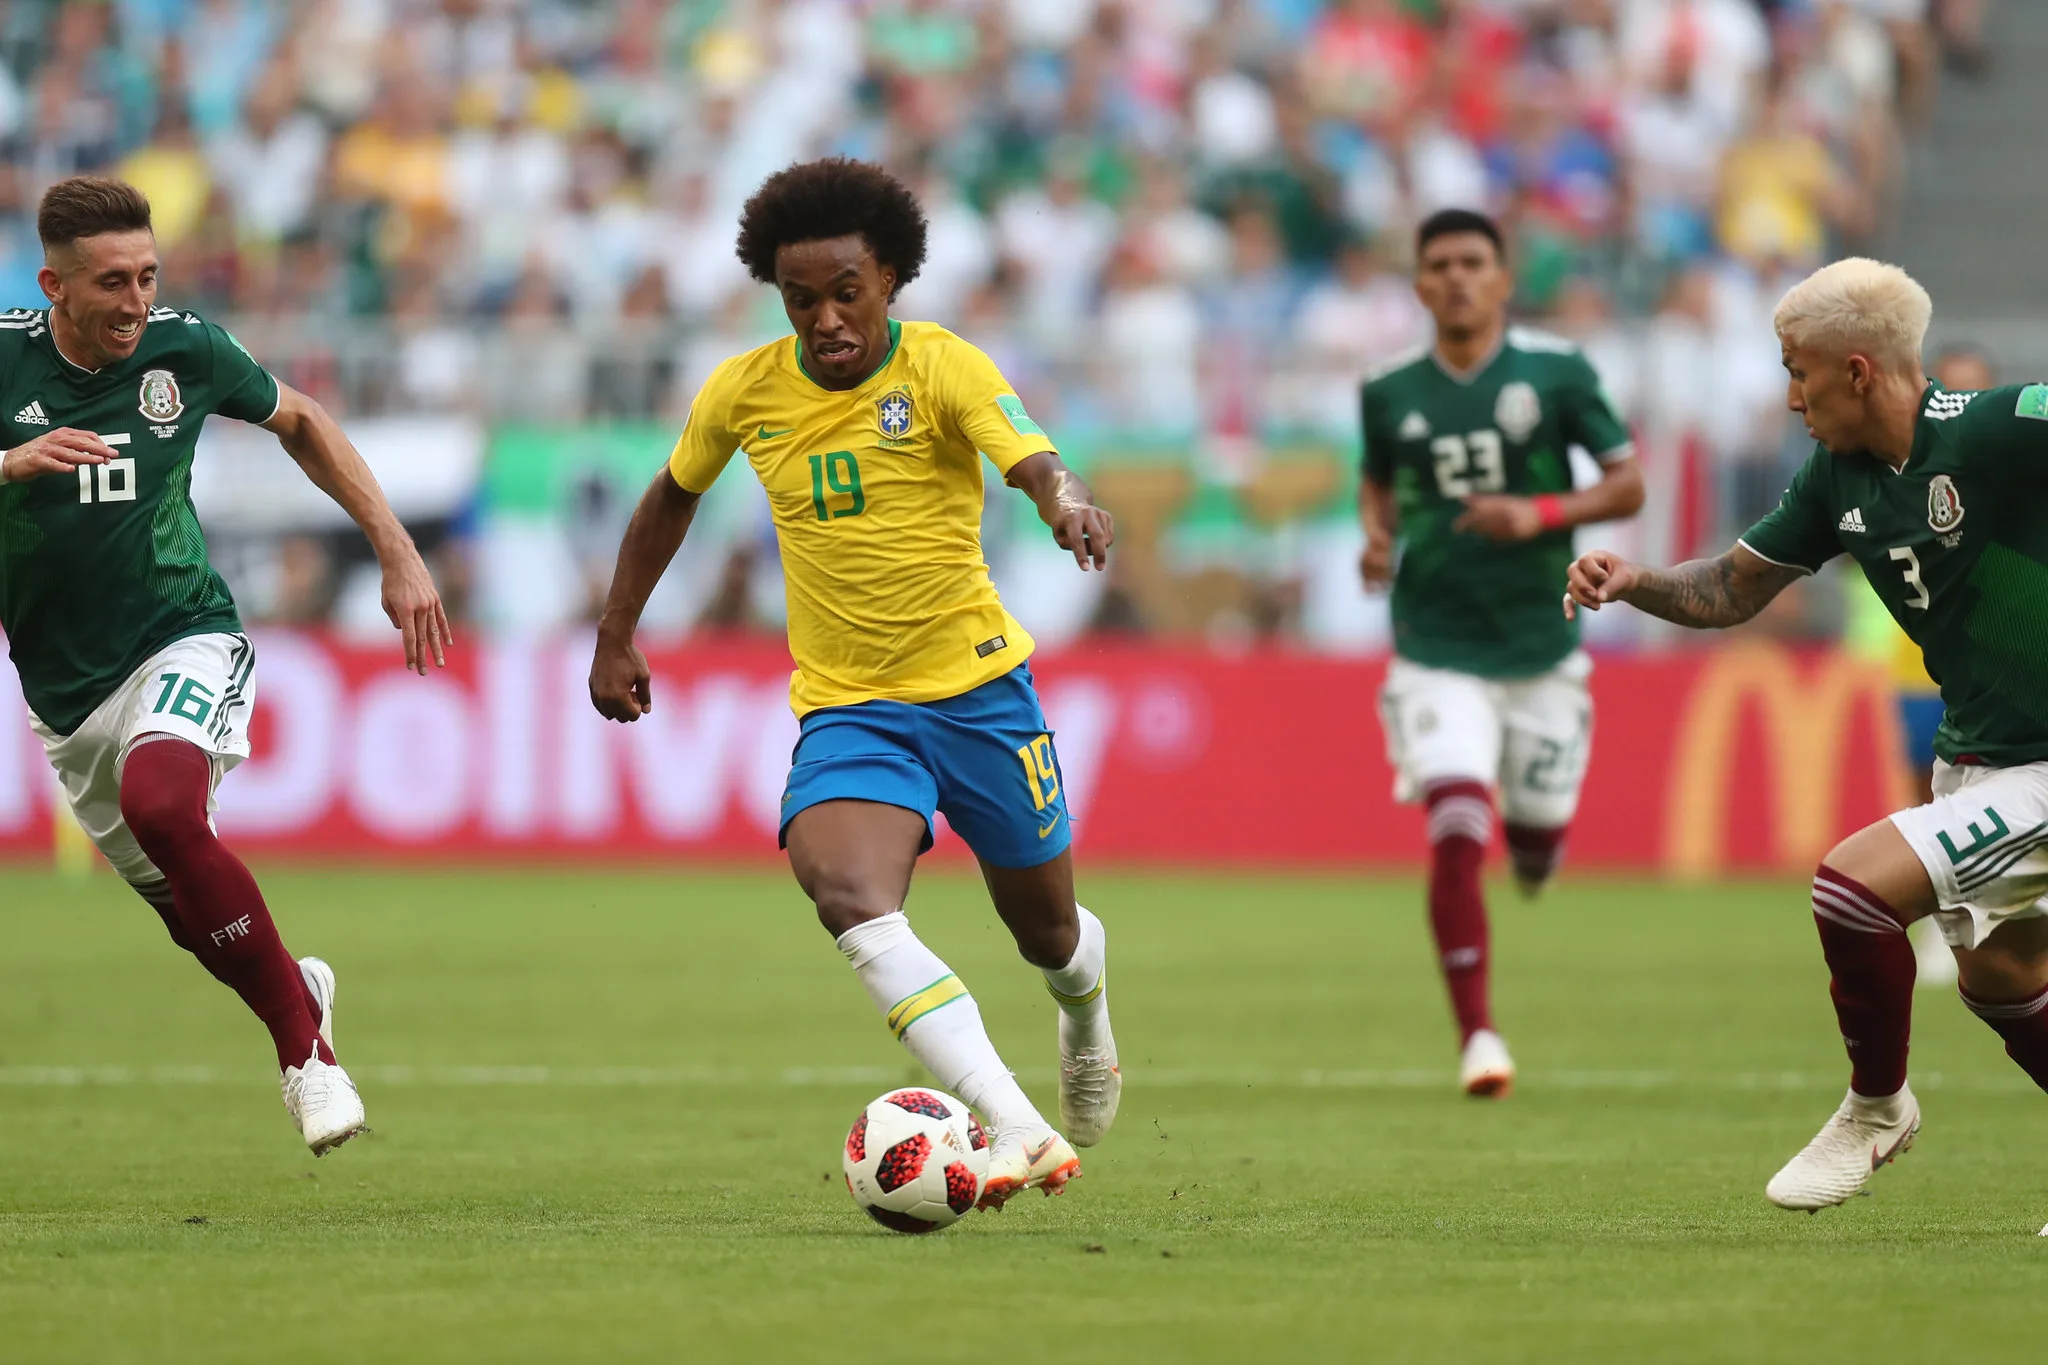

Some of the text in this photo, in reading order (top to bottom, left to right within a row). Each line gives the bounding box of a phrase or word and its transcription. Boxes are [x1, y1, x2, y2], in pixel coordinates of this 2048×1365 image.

[15, 414, 49, 426] adidas
[78, 432, 137, 504] 16
[808, 450, 866, 521] 19
[1429, 428, 1507, 499] 23
[1838, 521, 1867, 533] adidas
[1888, 546, 1930, 610] 3
[152, 672, 215, 728] 16
[1017, 733, 1060, 812] 19
[1935, 806, 2011, 866] 3
[210, 913, 252, 947] FMF
